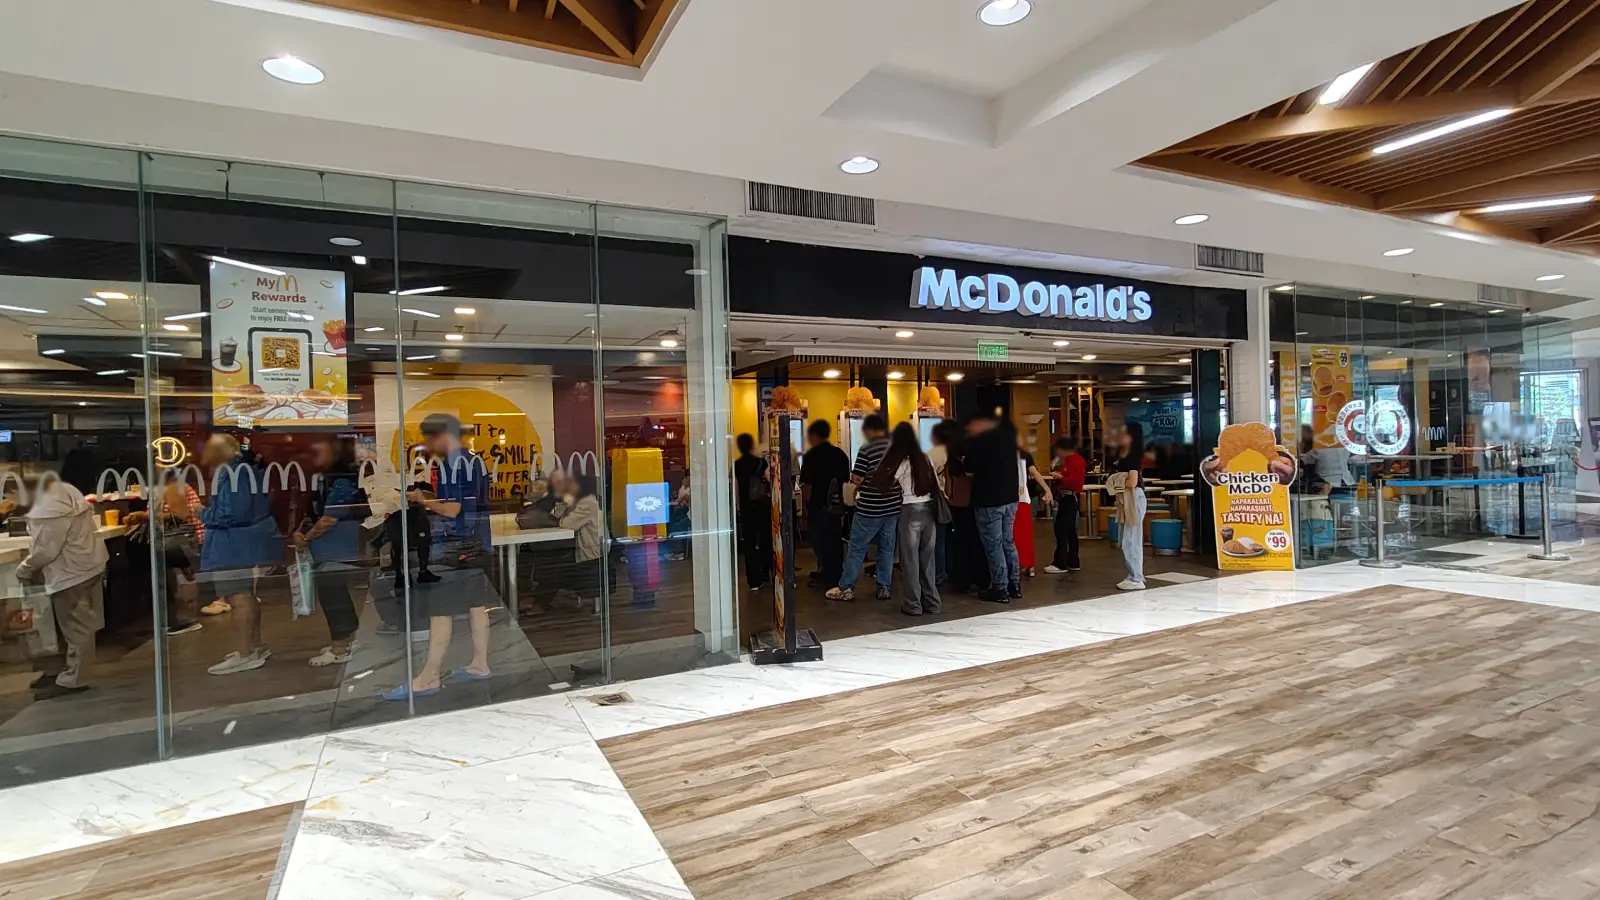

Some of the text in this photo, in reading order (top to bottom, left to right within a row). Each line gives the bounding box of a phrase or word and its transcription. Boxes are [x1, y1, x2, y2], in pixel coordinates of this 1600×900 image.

[256, 277, 276, 290] My
[251, 291, 307, 304] Rewards
[912, 266, 1153, 321] McDonald's
[1218, 473, 1278, 484] Chicken
[1229, 485, 1272, 494] McDo
[1221, 512, 1283, 524] TASTIFY NA!
